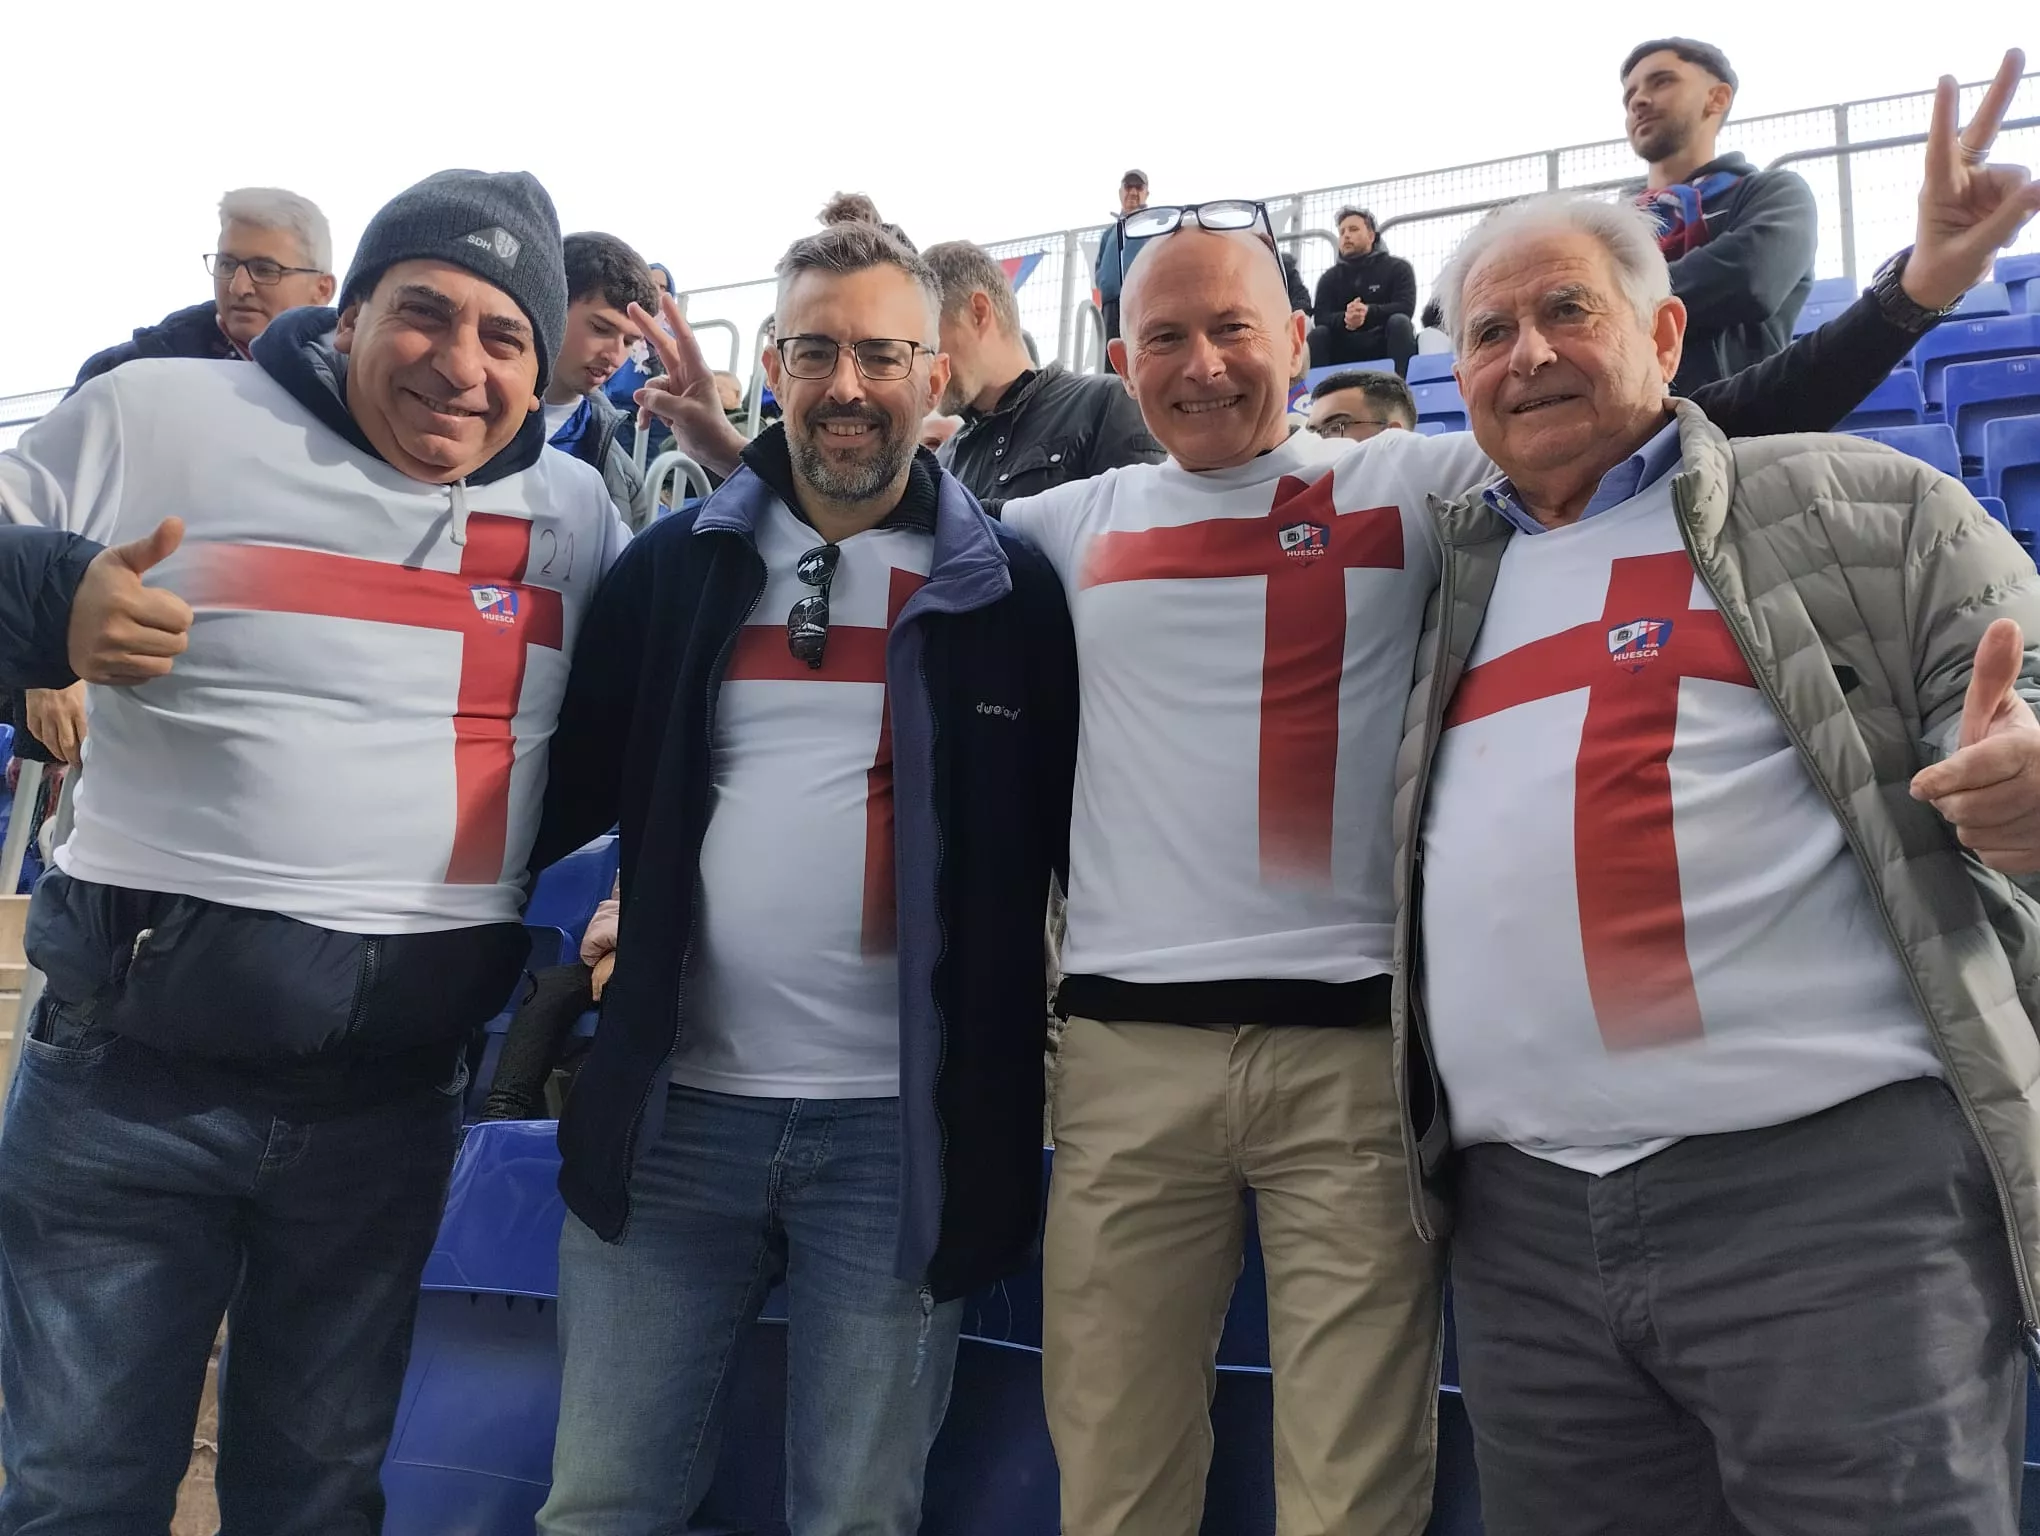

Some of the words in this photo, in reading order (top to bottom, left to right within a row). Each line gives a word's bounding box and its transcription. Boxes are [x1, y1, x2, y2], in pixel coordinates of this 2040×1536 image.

[467, 234, 492, 251] SDH
[540, 528, 575, 582] 21
[1287, 549, 1325, 557] HUESCA
[482, 612, 515, 624] HUESCA
[1613, 650, 1659, 662] HUESCA
